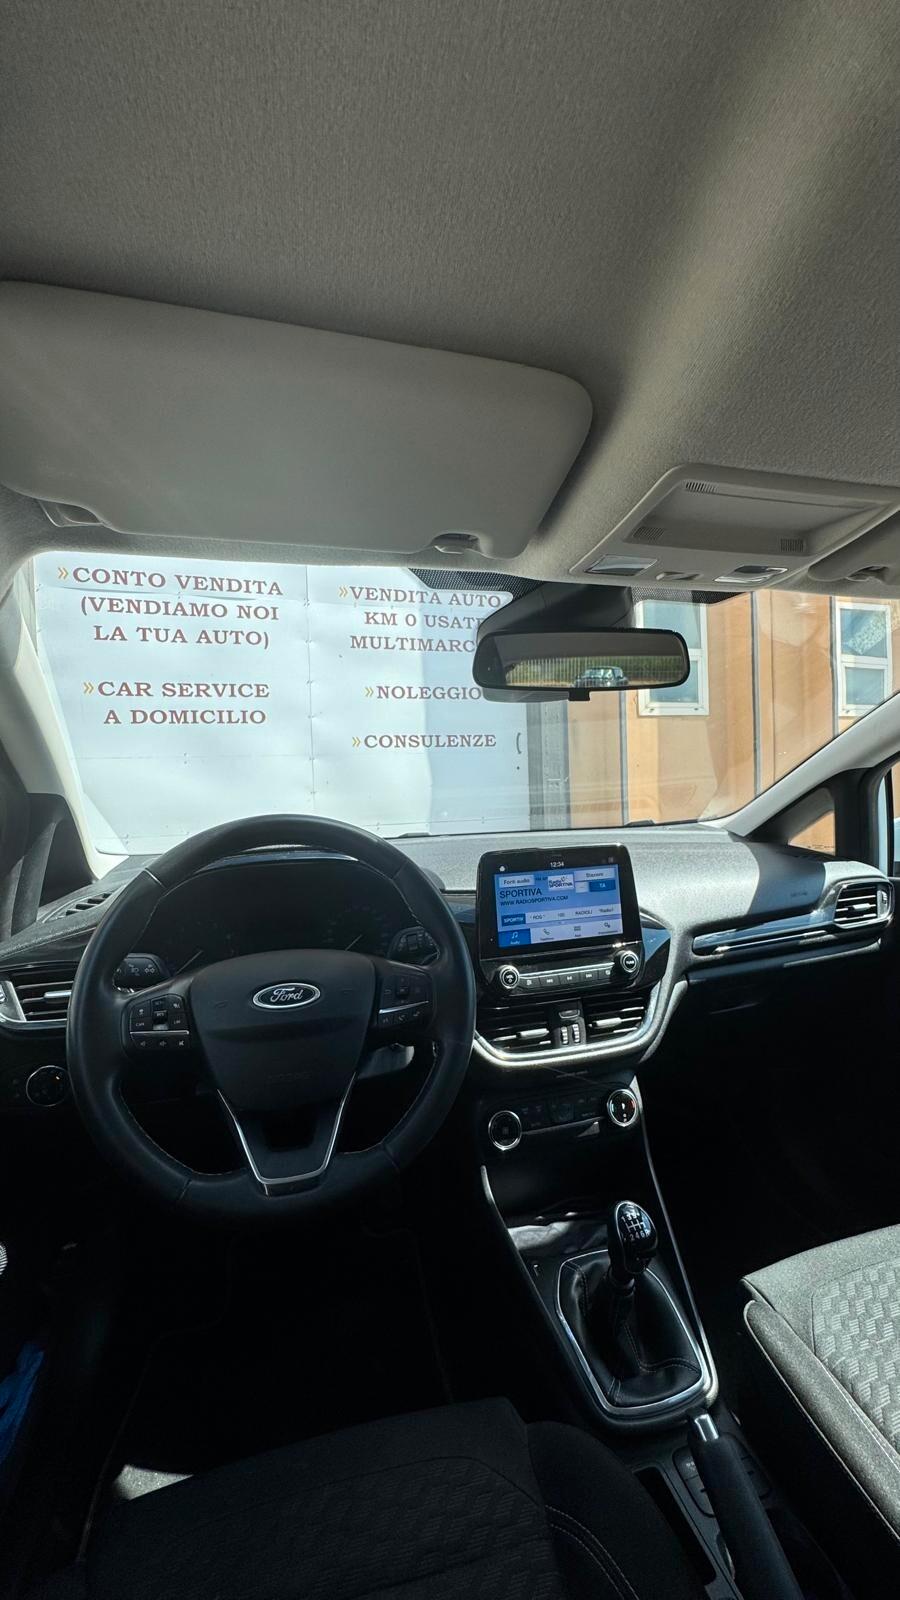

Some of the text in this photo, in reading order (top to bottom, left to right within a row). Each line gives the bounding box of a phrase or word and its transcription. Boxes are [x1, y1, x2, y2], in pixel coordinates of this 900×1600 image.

[72, 567, 283, 596] CONTO VENDITA
[349, 586, 501, 608] VENDITA AUTO
[81, 596, 279, 621] (VENDIAMO NOI
[364, 612, 398, 626] KM
[94, 625, 269, 650] LA TUA AUTO)
[350, 635, 475, 653] MULTIMARC
[98, 681, 270, 698] CAR SERVICE
[376, 686, 482, 700] NOLEGGIO
[104, 709, 266, 725] A DOMICILIO
[364, 734, 497, 749] CONSULENZE
[499, 888, 542, 899] SPORTIVA
[270, 987, 304, 1002] Ford
